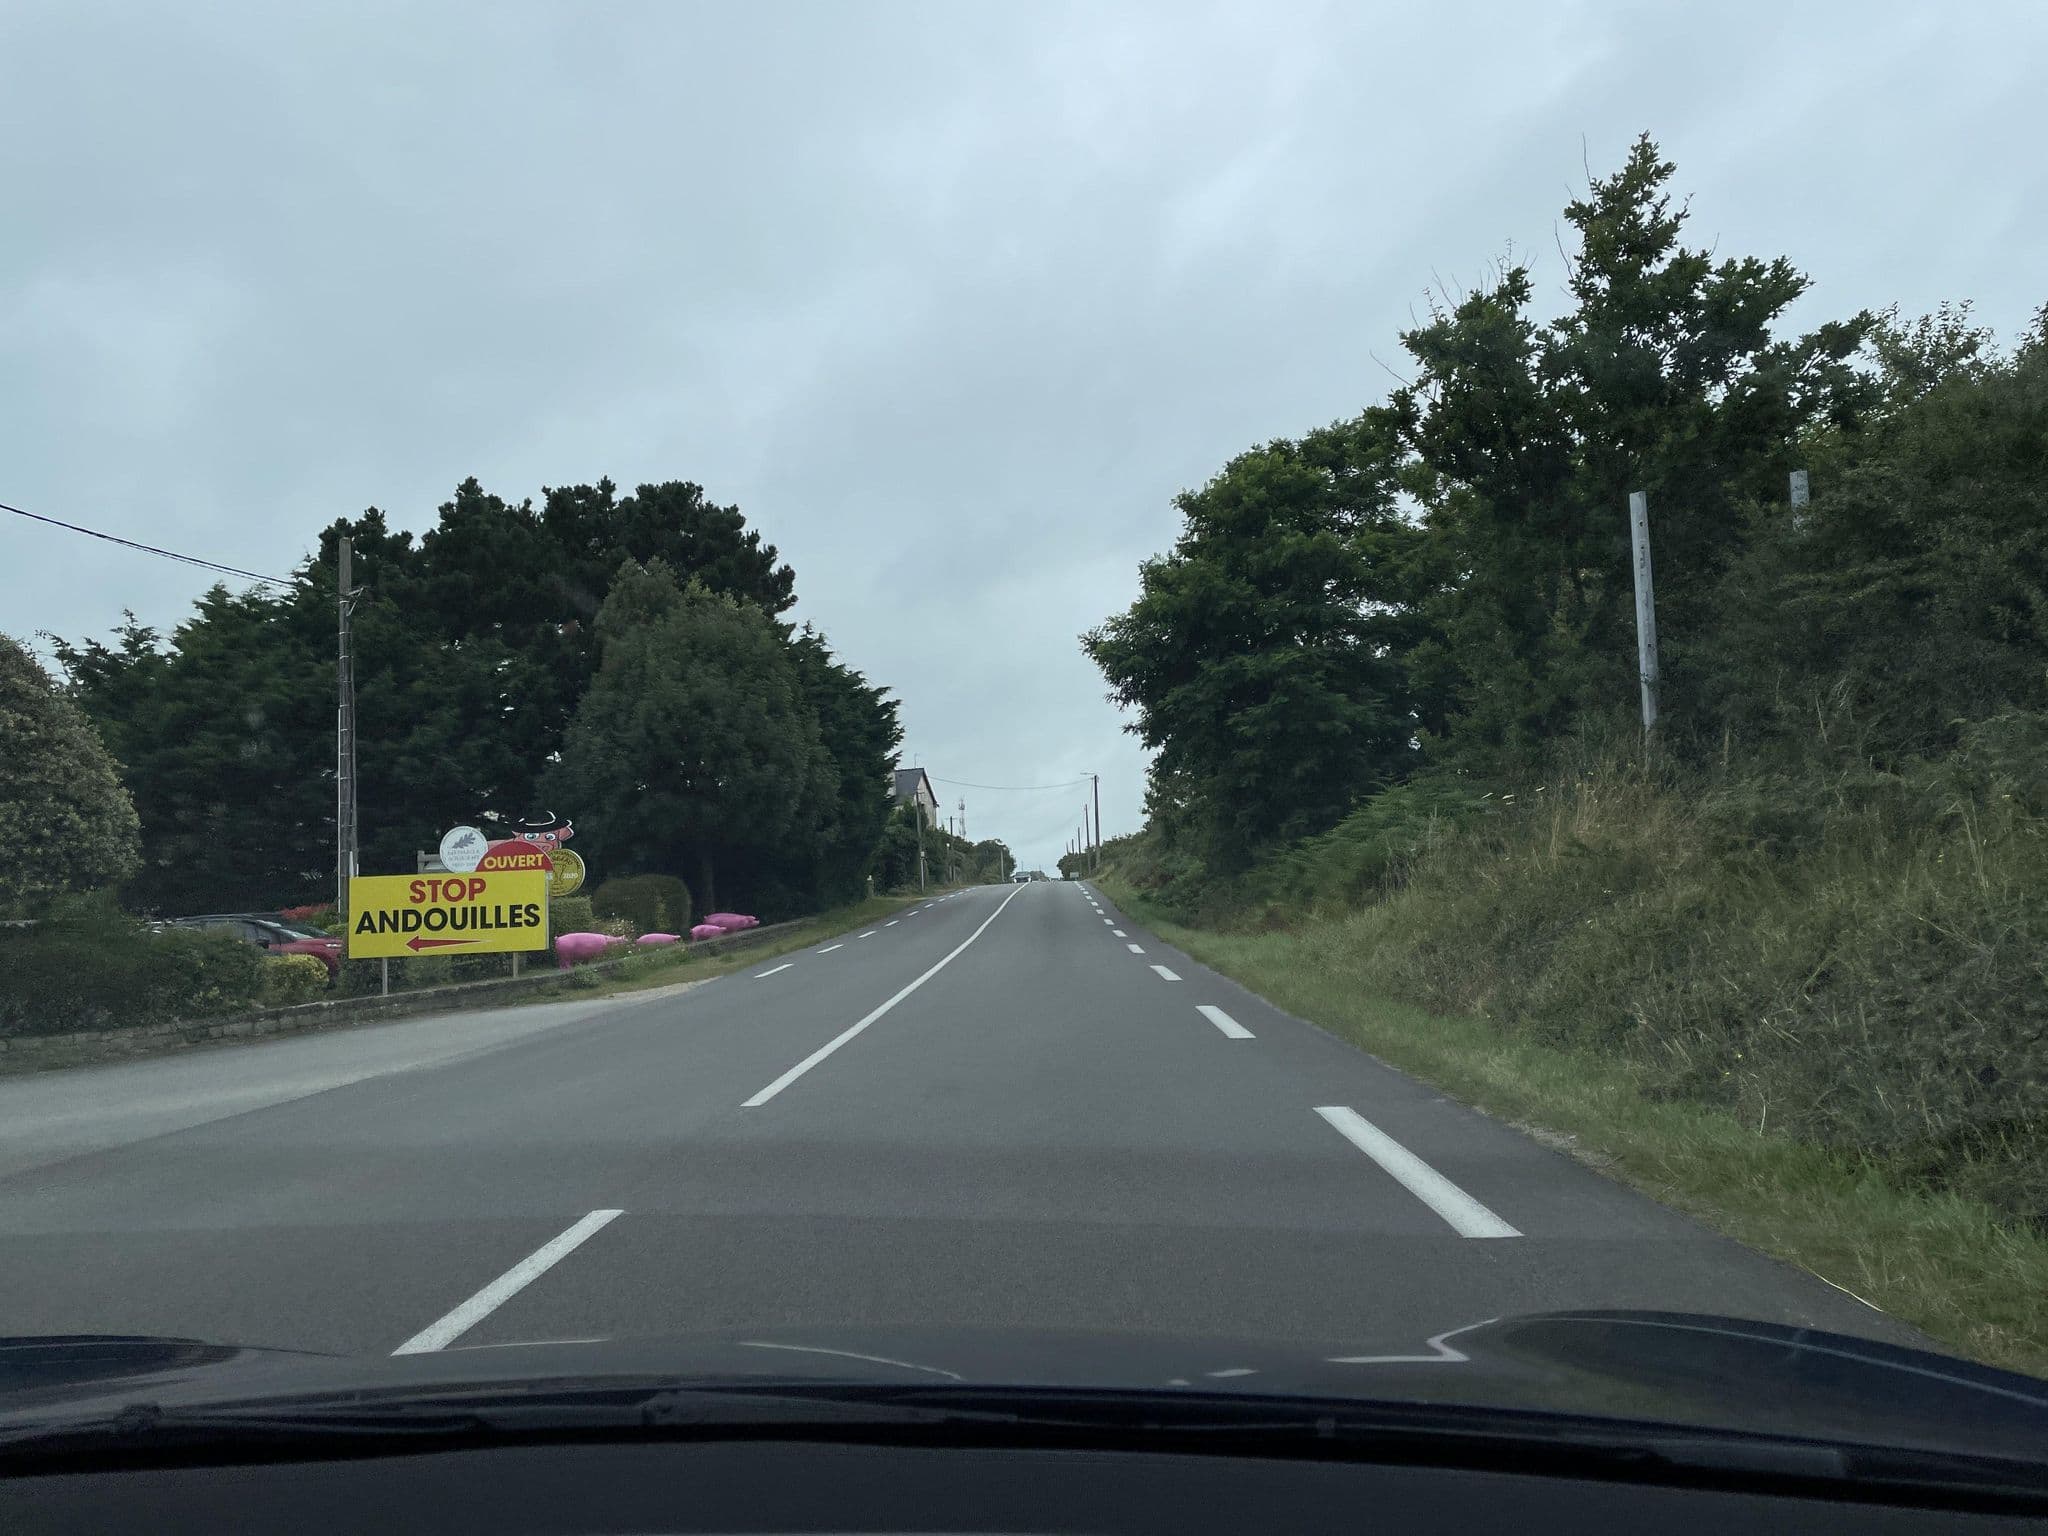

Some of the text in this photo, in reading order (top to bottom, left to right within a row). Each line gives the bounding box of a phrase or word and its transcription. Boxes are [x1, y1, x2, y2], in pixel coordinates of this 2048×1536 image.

[484, 854, 544, 869] OUVERT
[409, 878, 486, 903] STOP
[355, 903, 540, 935] ANDOUILLES
